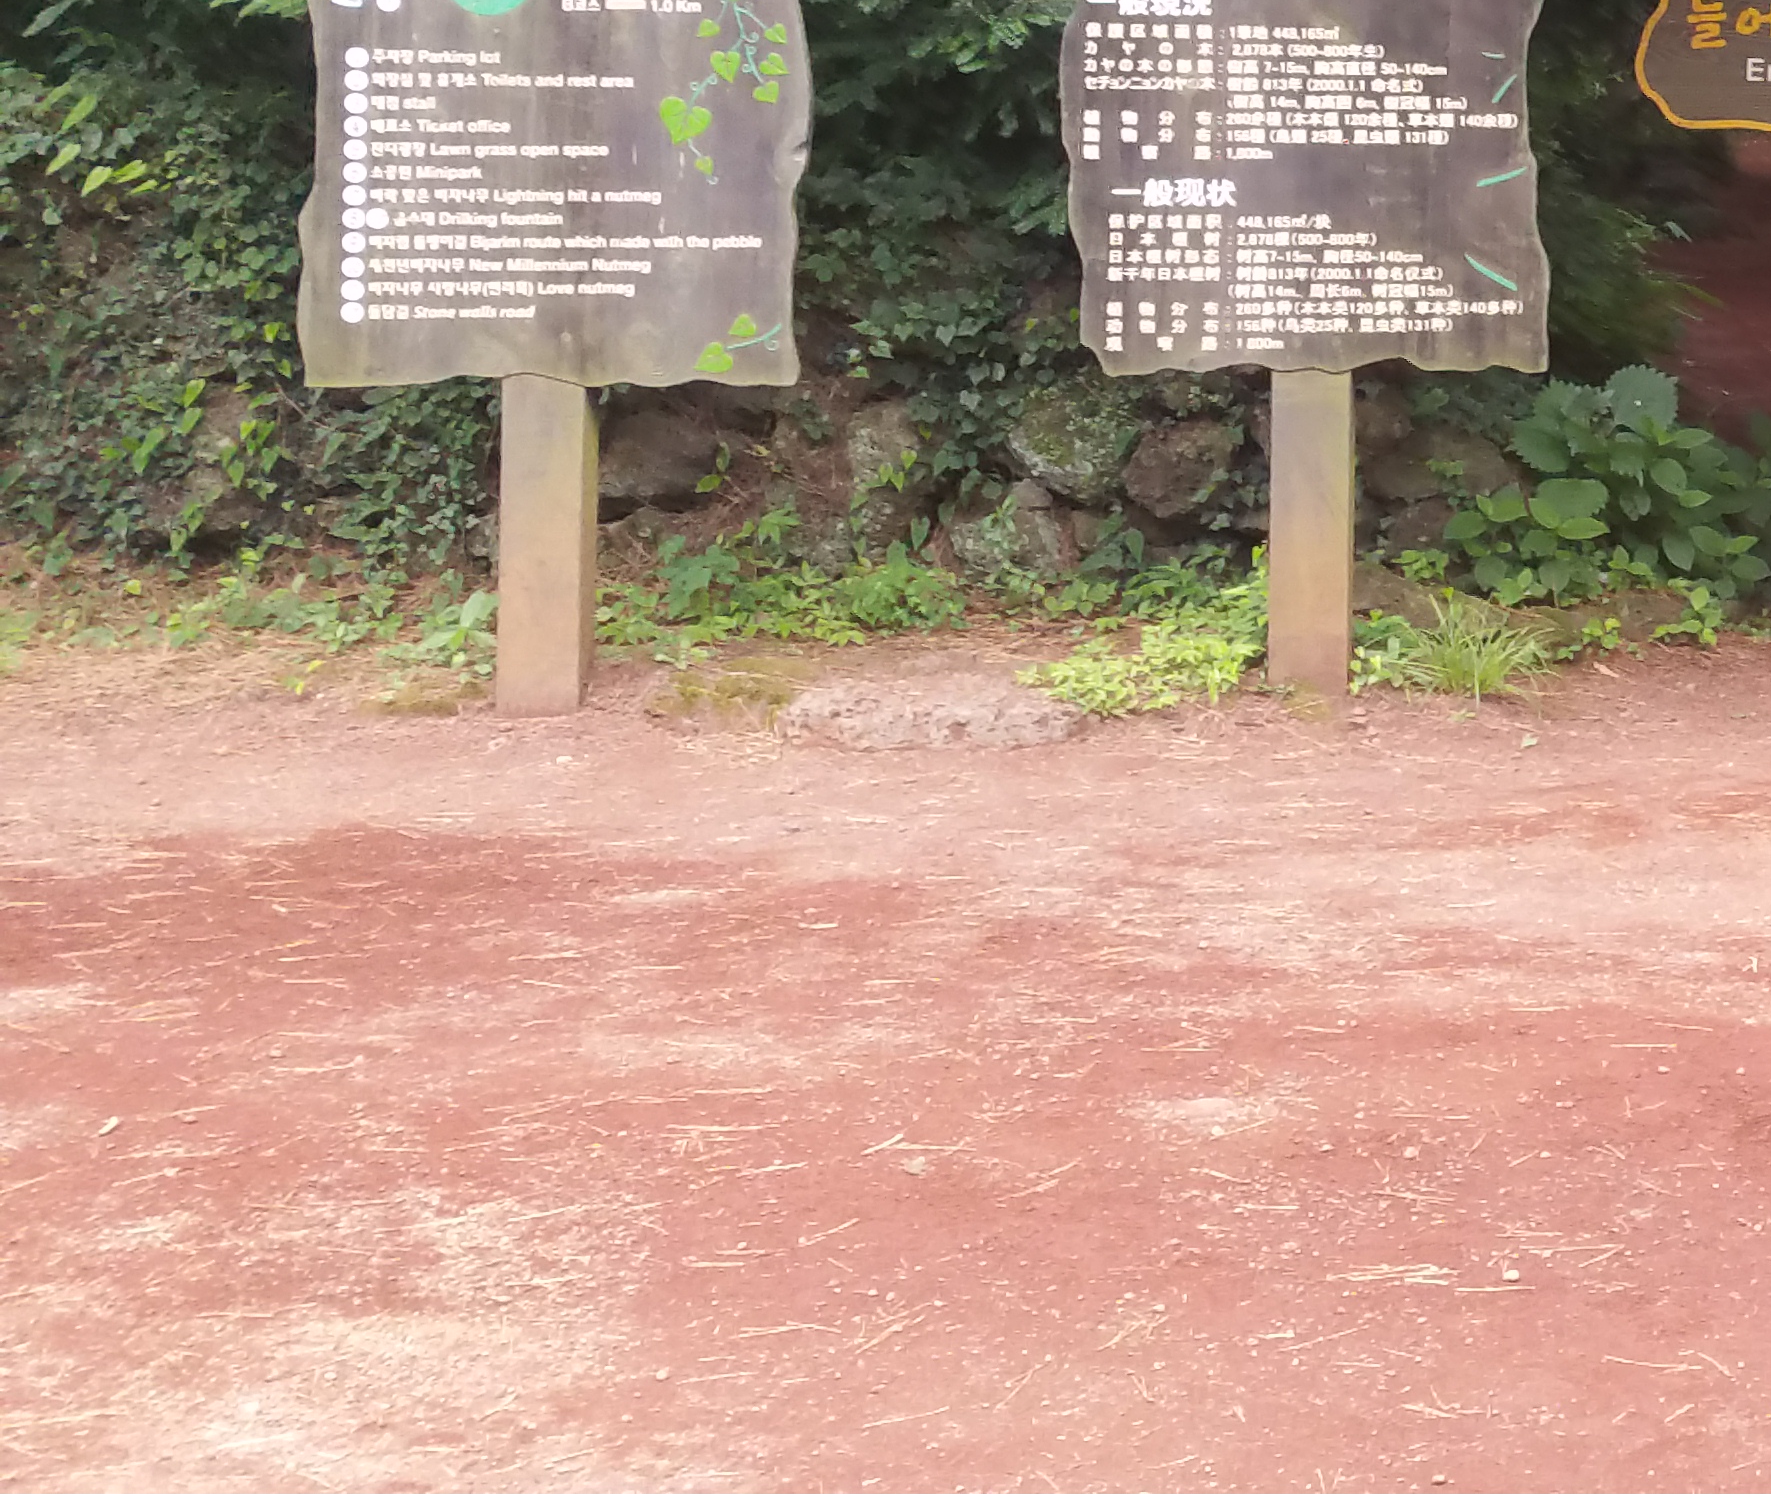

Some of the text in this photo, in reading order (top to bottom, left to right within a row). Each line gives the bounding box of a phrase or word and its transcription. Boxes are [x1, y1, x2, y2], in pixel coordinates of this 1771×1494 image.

[676, 0, 701, 13] Km
[372, 49, 500, 66] 주차장 Parking lot
[481, 73, 531, 86] Toilets
[534, 74, 564, 87] and
[566, 75, 597, 87] rest
[600, 77, 634, 87] area
[402, 97, 436, 109] stall
[416, 119, 464, 132] Ticket
[466, 120, 511, 133] office
[430, 143, 471, 155] Lawn
[474, 146, 517, 158] grass
[520, 146, 559, 158] open
[562, 146, 609, 158] space
[416, 166, 482, 181] Minipark
[493, 189, 564, 205] Lightning
[591, 192, 601, 202] a
[605, 190, 661, 205] nutmeg
[1110, 178, 1237, 207] 一般现状
[501, 212, 563, 225] fountain
[564, 235, 607, 248] which
[610, 236, 650, 248] made
[653, 236, 684, 248] with
[686, 236, 709, 248] the
[469, 258, 503, 271] New
[592, 258, 651, 274] Nutmeg
[537, 282, 575, 294] Love
[578, 282, 635, 297] nutmeg
[499, 305, 535, 318] road
